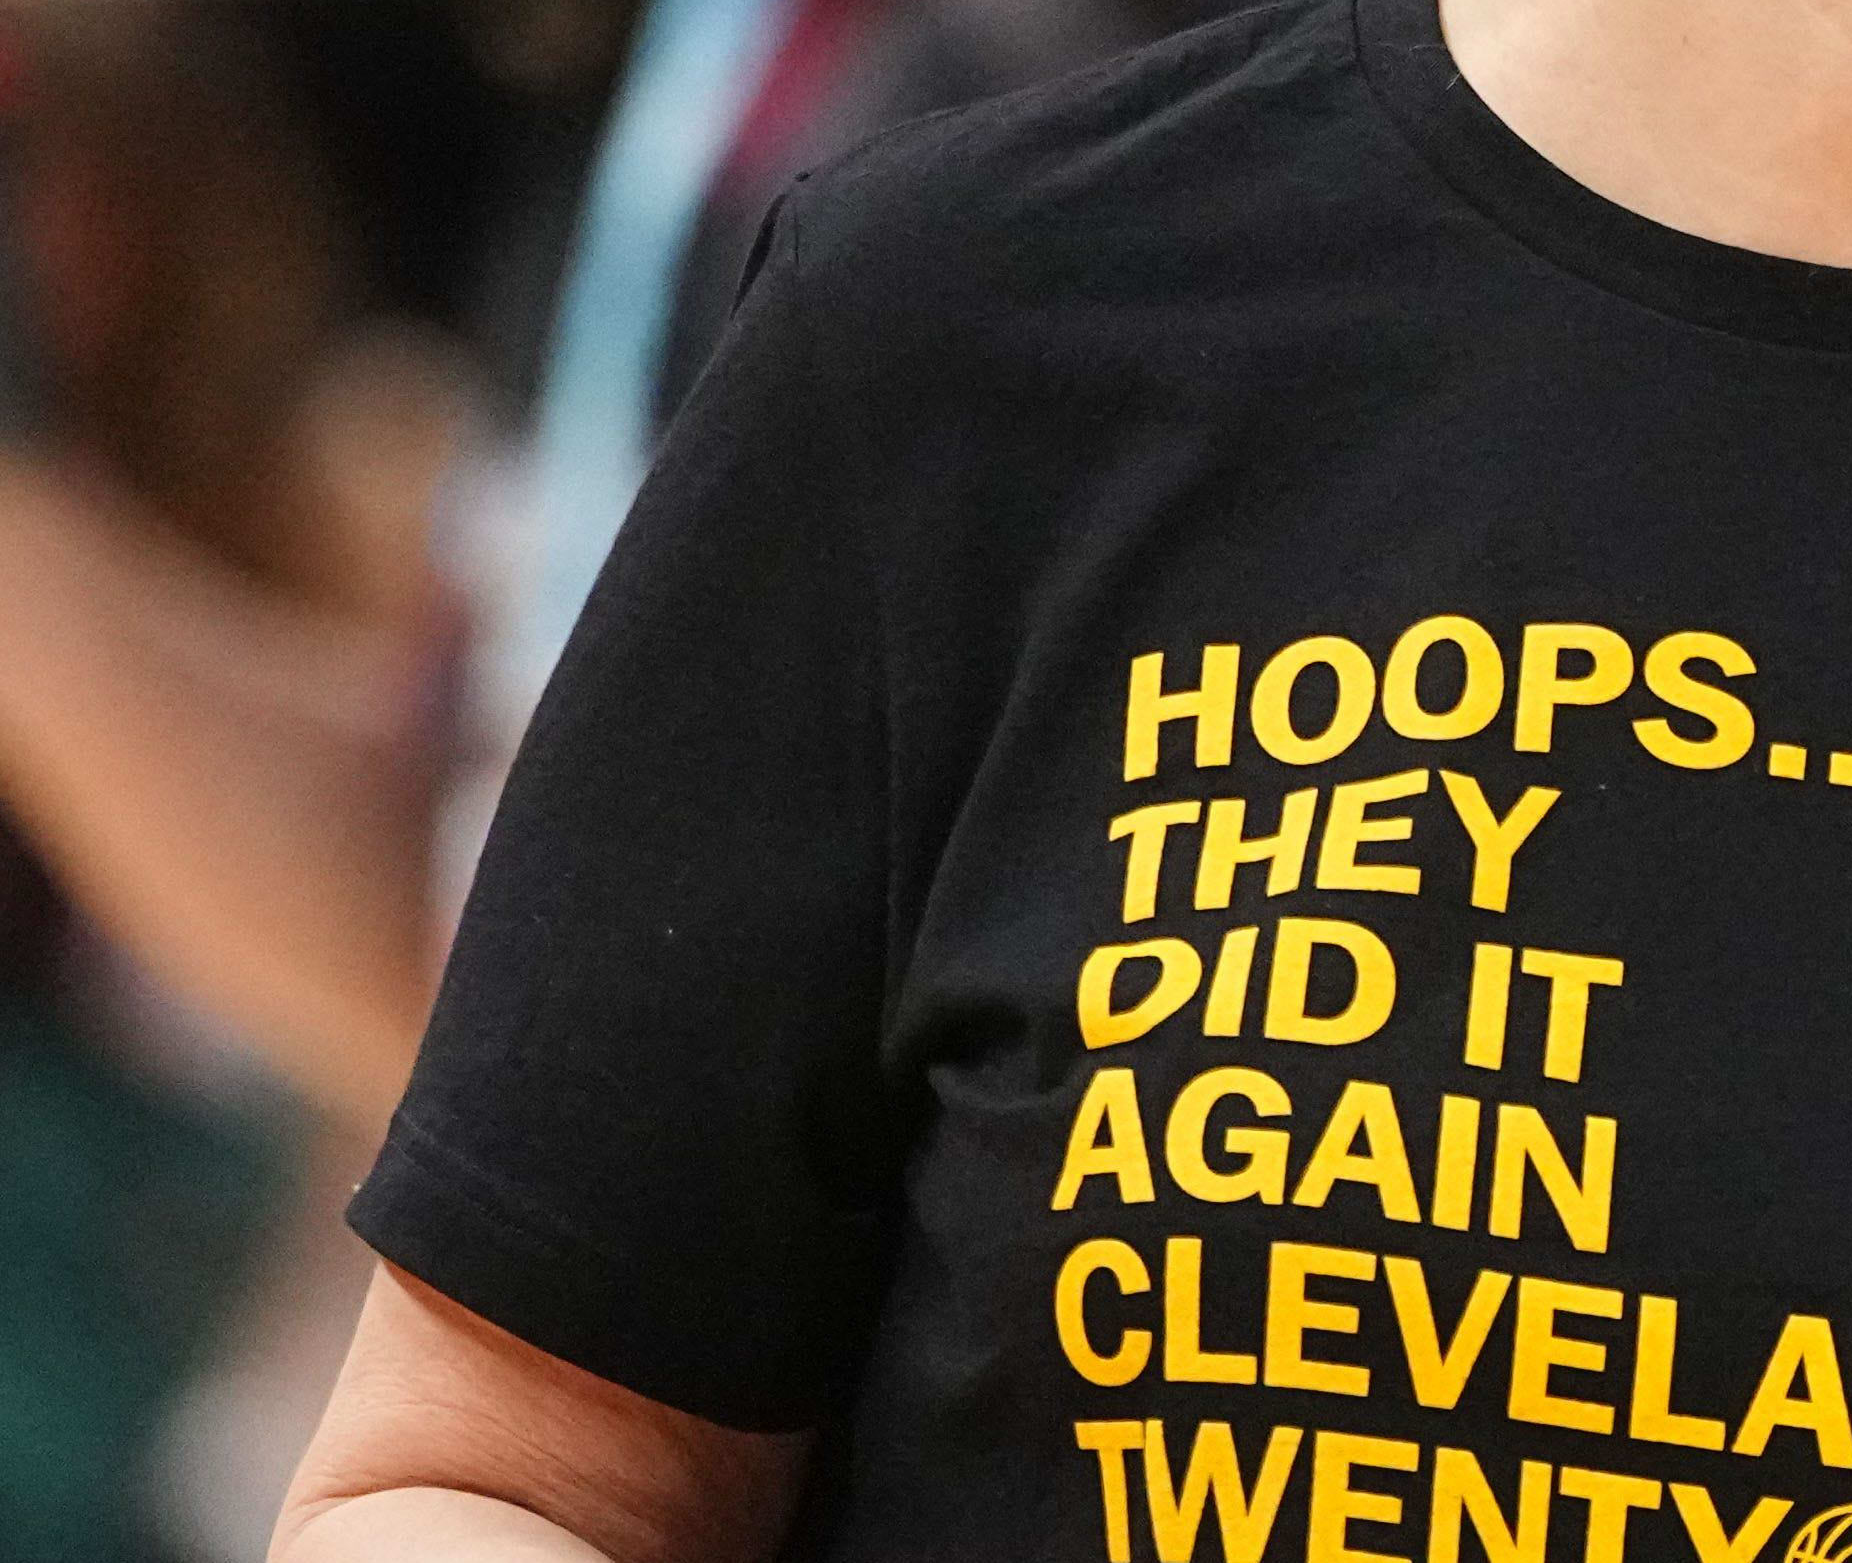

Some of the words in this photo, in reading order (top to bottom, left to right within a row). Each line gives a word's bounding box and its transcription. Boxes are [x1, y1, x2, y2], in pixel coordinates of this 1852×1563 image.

[1108, 768, 1562, 924] THEY
[1076, 916, 1397, 1050] DID
[1464, 941, 1625, 1084] IT
[1050, 1066, 1618, 1254] AGAIN
